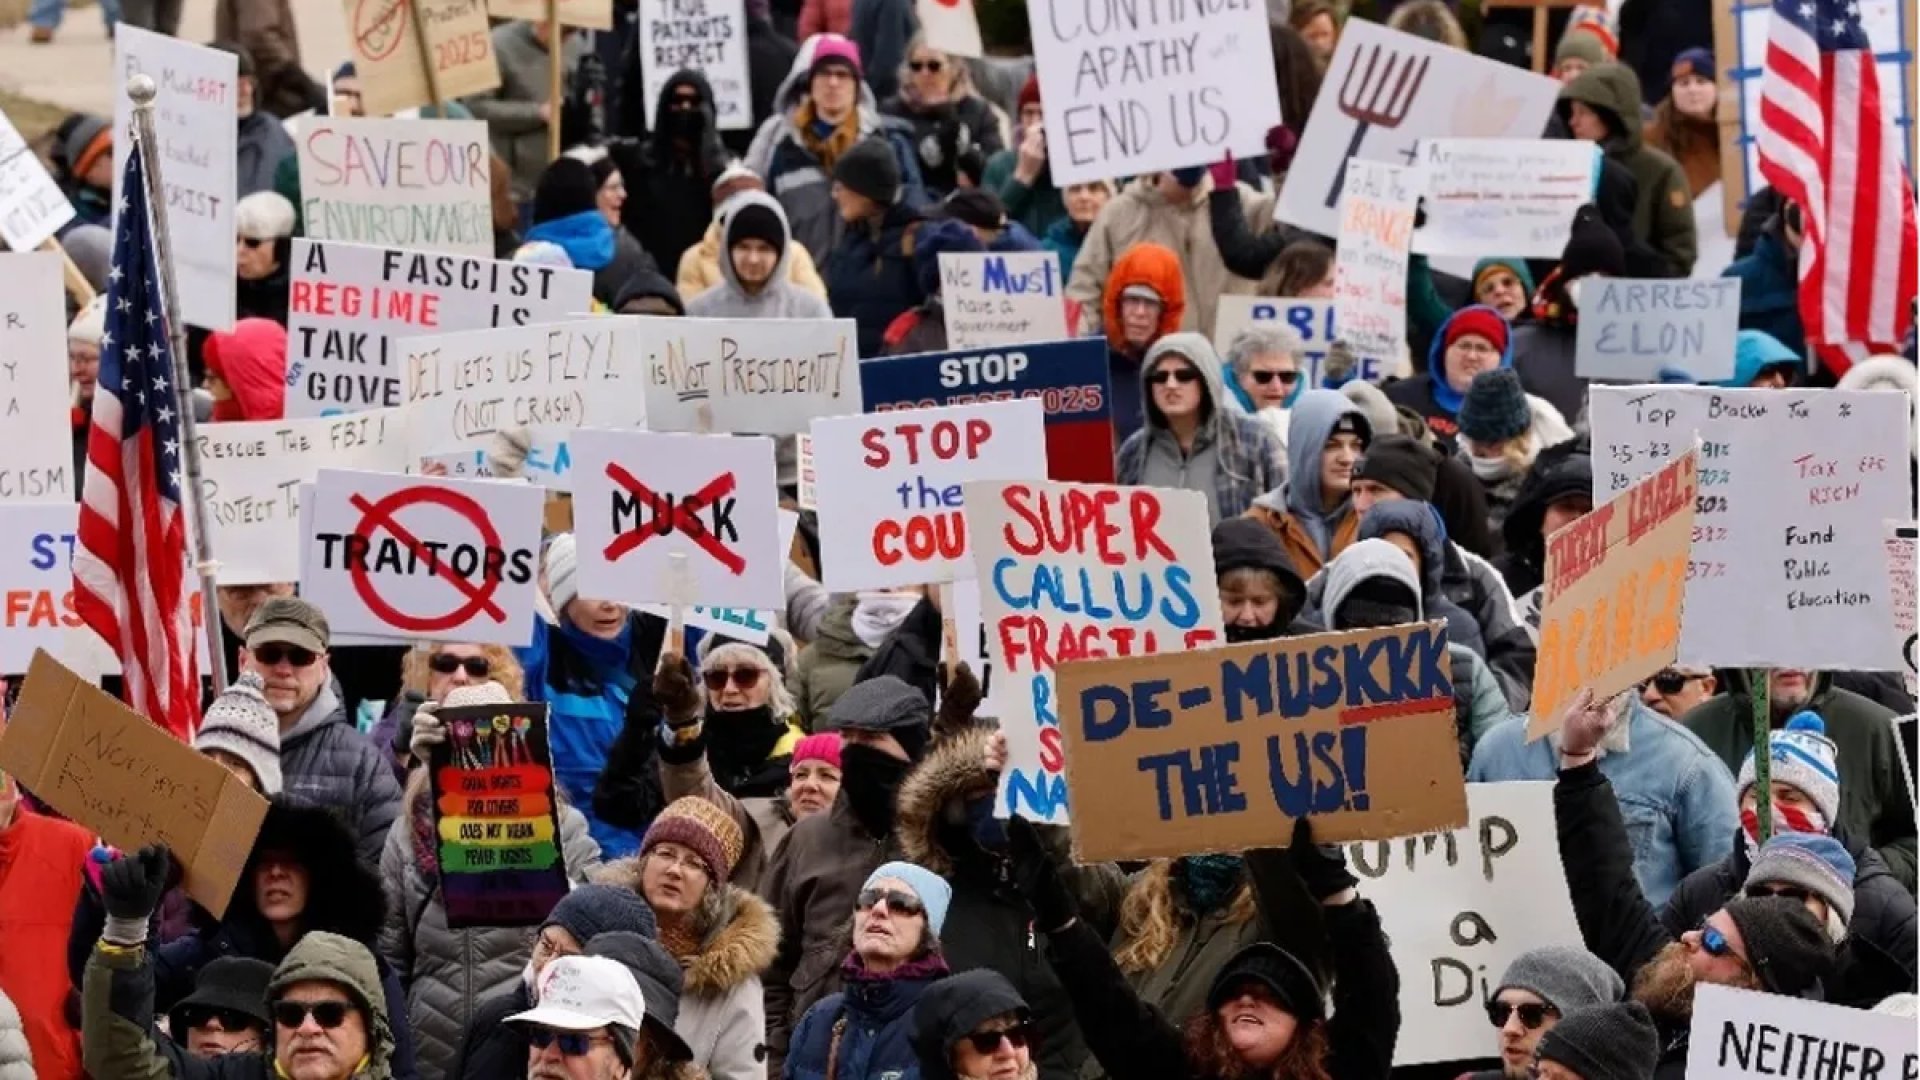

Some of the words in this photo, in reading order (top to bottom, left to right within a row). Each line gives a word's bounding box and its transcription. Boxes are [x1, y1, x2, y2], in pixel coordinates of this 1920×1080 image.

[435, 32, 488, 71] 2025
[1075, 33, 1199, 97] APATHY
[1063, 99, 1152, 166] END
[1169, 86, 1230, 147] US
[307, 127, 426, 189] SAVE
[426, 138, 488, 188] OUR
[305, 242, 327, 274] A
[382, 249, 556, 301] FASCIST
[945, 260, 973, 288] We
[983, 255, 1058, 297] Must
[291, 280, 440, 329] REGIME
[491, 303, 531, 329] IS
[955, 294, 996, 316] have
[1000, 300, 1017, 316] a
[1596, 282, 1734, 315] ARREST
[298, 327, 388, 367] TAKI
[1595, 321, 1704, 358] ELON
[407, 347, 443, 402] DEI
[505, 349, 534, 384] US
[546, 329, 620, 384] FLY!
[939, 352, 1029, 389] STOP
[307, 371, 400, 407] GOVE
[1626, 393, 1677, 428] Top
[860, 418, 993, 469] STOP
[1792, 452, 1839, 480] Tax
[0, 464, 66, 498] CISM
[897, 475, 965, 509] the
[612, 489, 739, 543] MUSK
[871, 510, 966, 567] COU
[1001, 484, 1178, 566] SUPER
[1785, 525, 1836, 547] Fund
[31, 533, 76, 571] ST
[316, 532, 534, 585] TRAITORS
[5, 589, 84, 630] FAS
[992, 557, 1201, 631] CALLUS
[1080, 627, 1453, 743] DE-MUSKKK
[1007, 768, 1070, 820] NA
[1137, 741, 1248, 821] THE
[1266, 725, 1371, 819] US!
[460, 823, 483, 840] DOES
[485, 823, 503, 839] NOT
[1449, 910, 1498, 947] a
[1430, 957, 1491, 1010] Di
[1717, 1019, 1887, 1080] NEITHER
